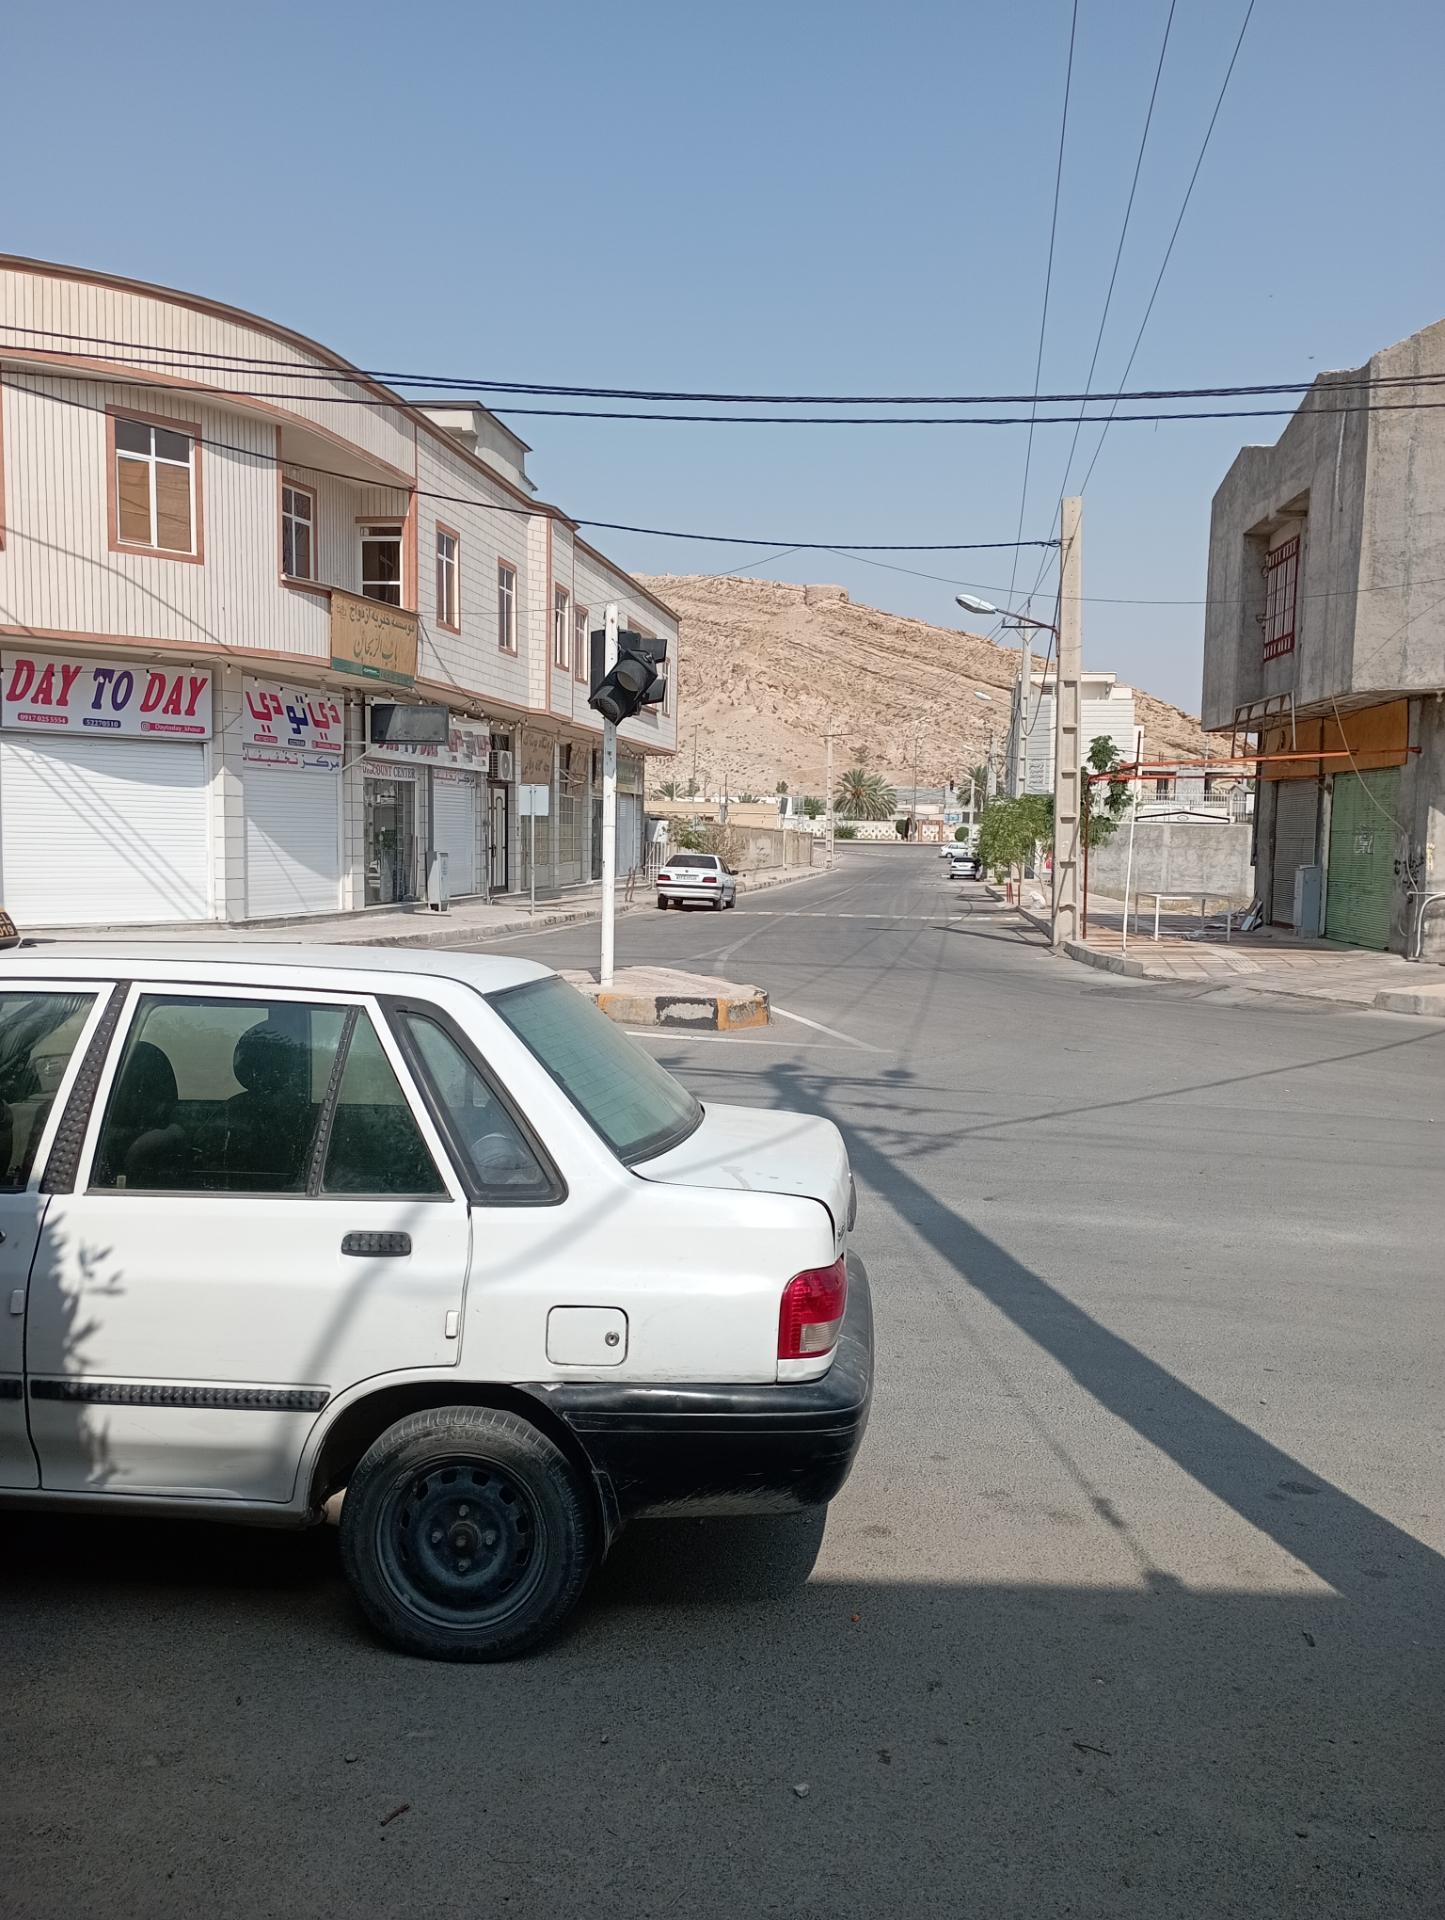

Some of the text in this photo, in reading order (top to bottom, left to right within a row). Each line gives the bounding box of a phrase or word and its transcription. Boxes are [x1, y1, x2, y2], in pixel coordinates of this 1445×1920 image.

[350, 605, 371, 624] ازدواج
[5, 657, 209, 717] DAY TO DAY
[300, 754, 340, 771] مرکز
[393, 766, 416, 779] CENTER
